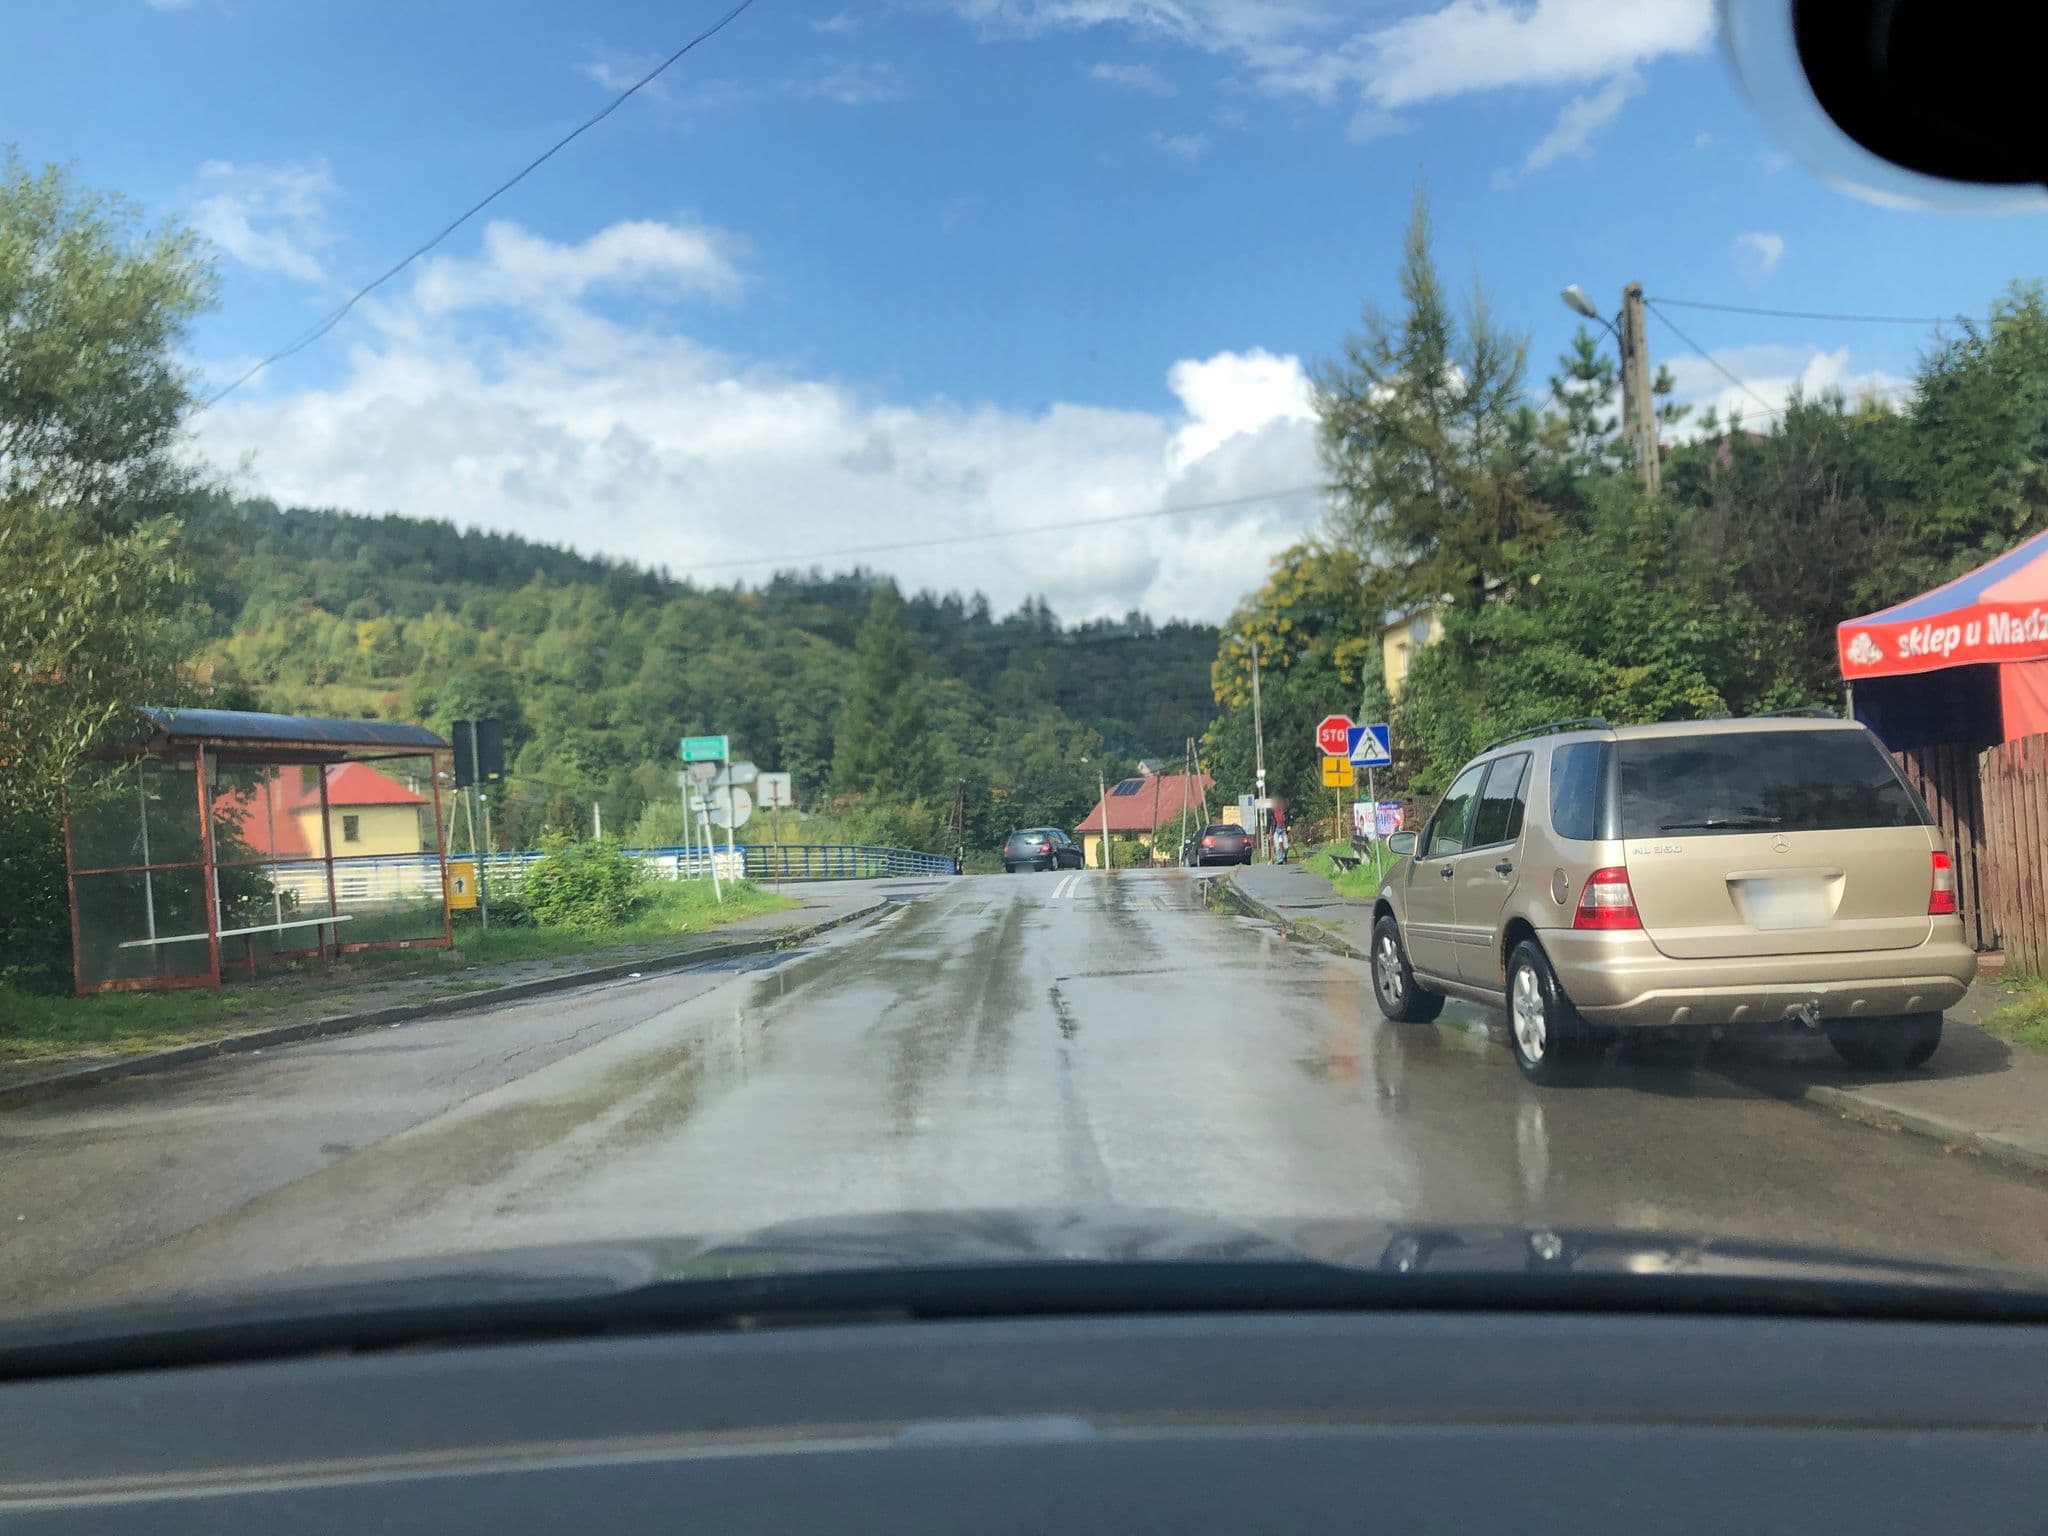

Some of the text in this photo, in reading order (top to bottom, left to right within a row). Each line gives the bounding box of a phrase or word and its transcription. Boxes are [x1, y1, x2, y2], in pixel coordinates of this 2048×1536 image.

[1898, 623, 1962, 658] sklep
[1965, 620, 1982, 646] u
[1322, 728, 1346, 742] STO
